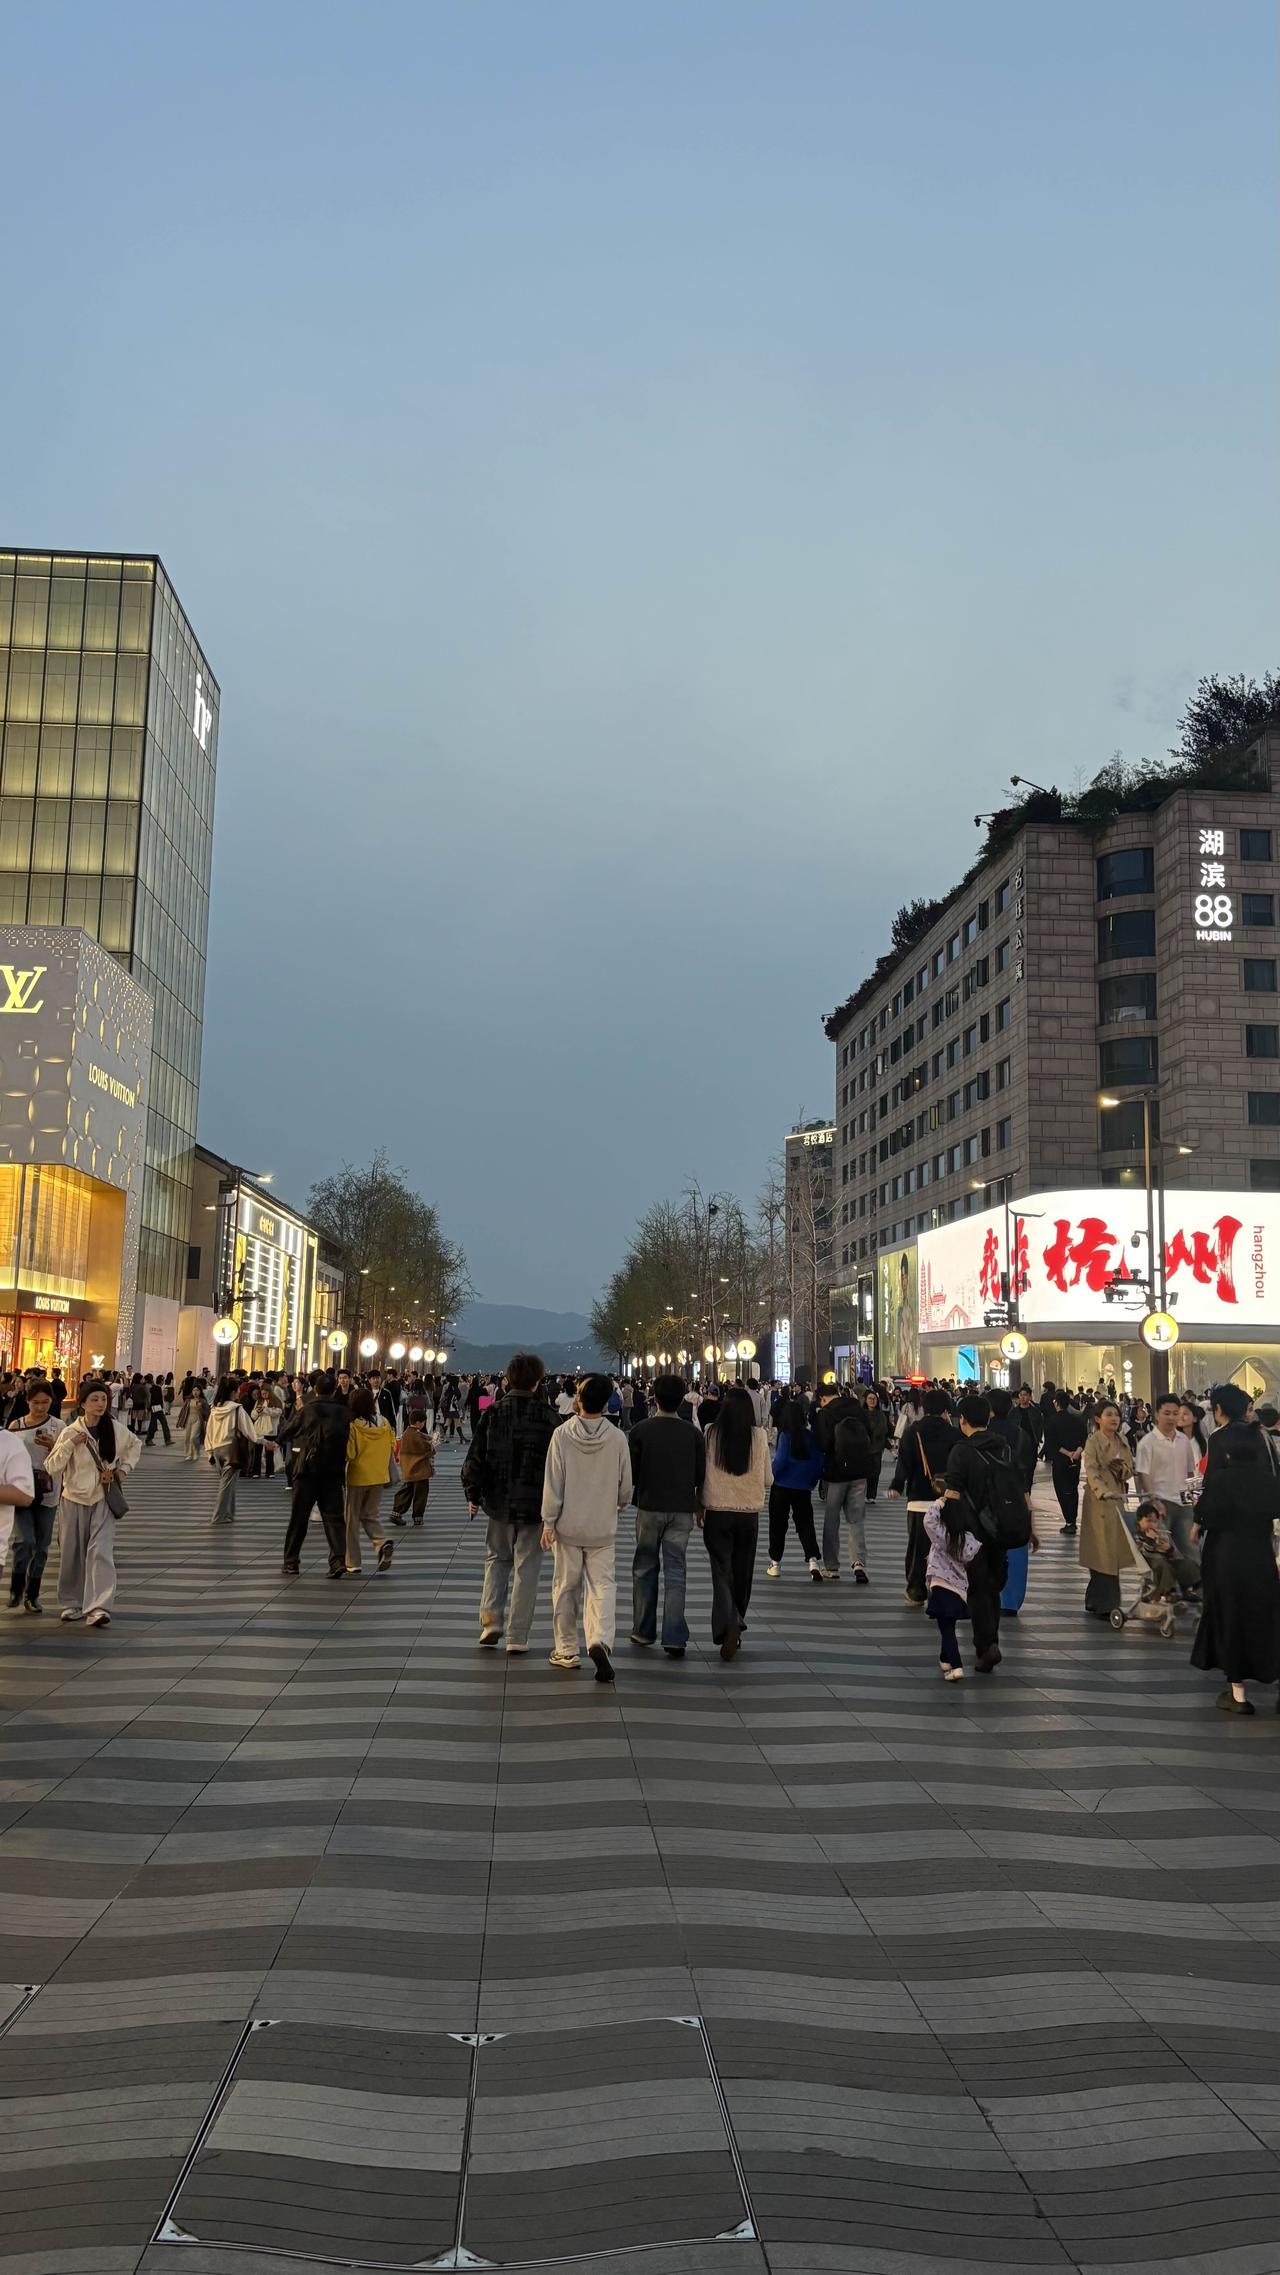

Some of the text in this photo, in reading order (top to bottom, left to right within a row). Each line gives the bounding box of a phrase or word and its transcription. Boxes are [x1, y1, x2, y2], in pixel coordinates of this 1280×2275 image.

[1195, 895, 1233, 928] 88
[1196, 930, 1232, 942] HUBIN
[88, 1062, 136, 1109] LOUIS VUITTON
[1252, 1225, 1265, 1299] hangzhou
[35, 1295, 70, 1314] LOUIS VUITTON
